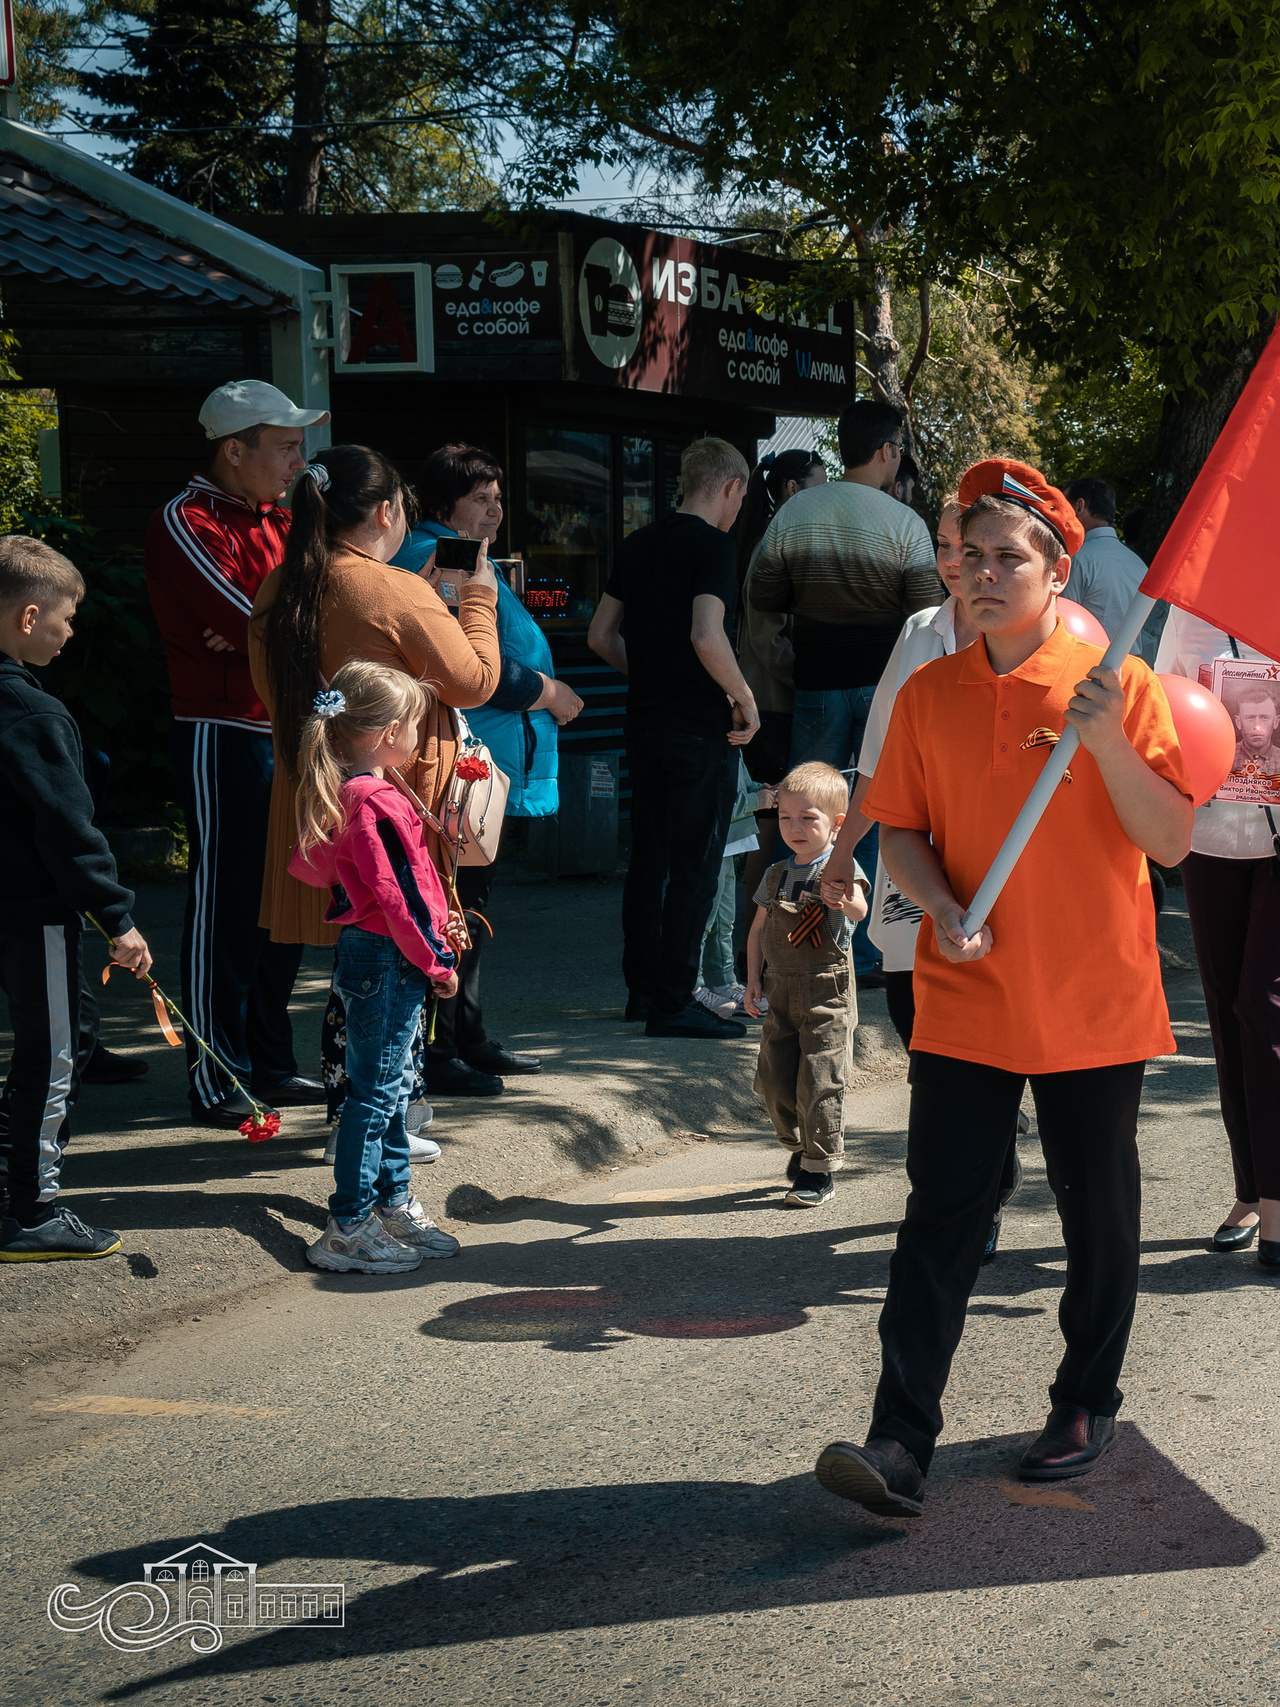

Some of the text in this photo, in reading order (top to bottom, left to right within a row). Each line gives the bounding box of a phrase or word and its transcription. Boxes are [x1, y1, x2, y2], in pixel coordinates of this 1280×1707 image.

[444, 297, 541, 318] еда&кофе
[473, 317, 530, 336] собой
[718, 327, 789, 361] еда&кофе
[739, 358, 781, 386] собой
[1229, 775, 1272, 786] Поздняков
